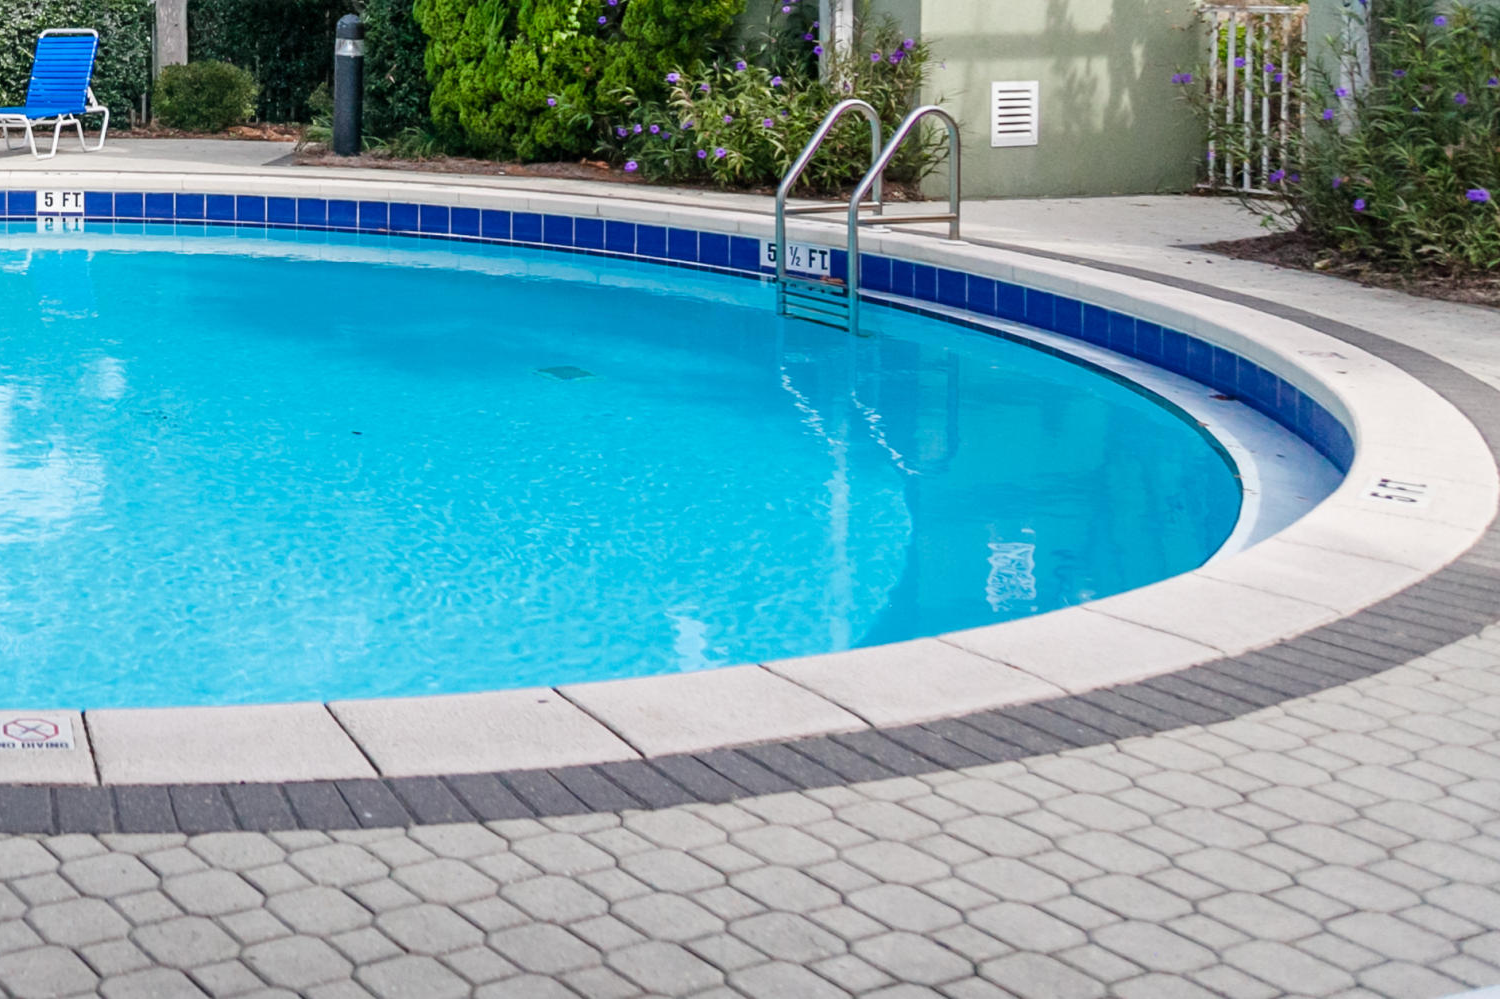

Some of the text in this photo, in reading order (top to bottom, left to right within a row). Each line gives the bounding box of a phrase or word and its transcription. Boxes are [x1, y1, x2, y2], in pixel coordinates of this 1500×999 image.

[44, 192, 54, 208] 5
[767, 242, 778, 263] 5
[21, 741, 70, 749] DIVING
